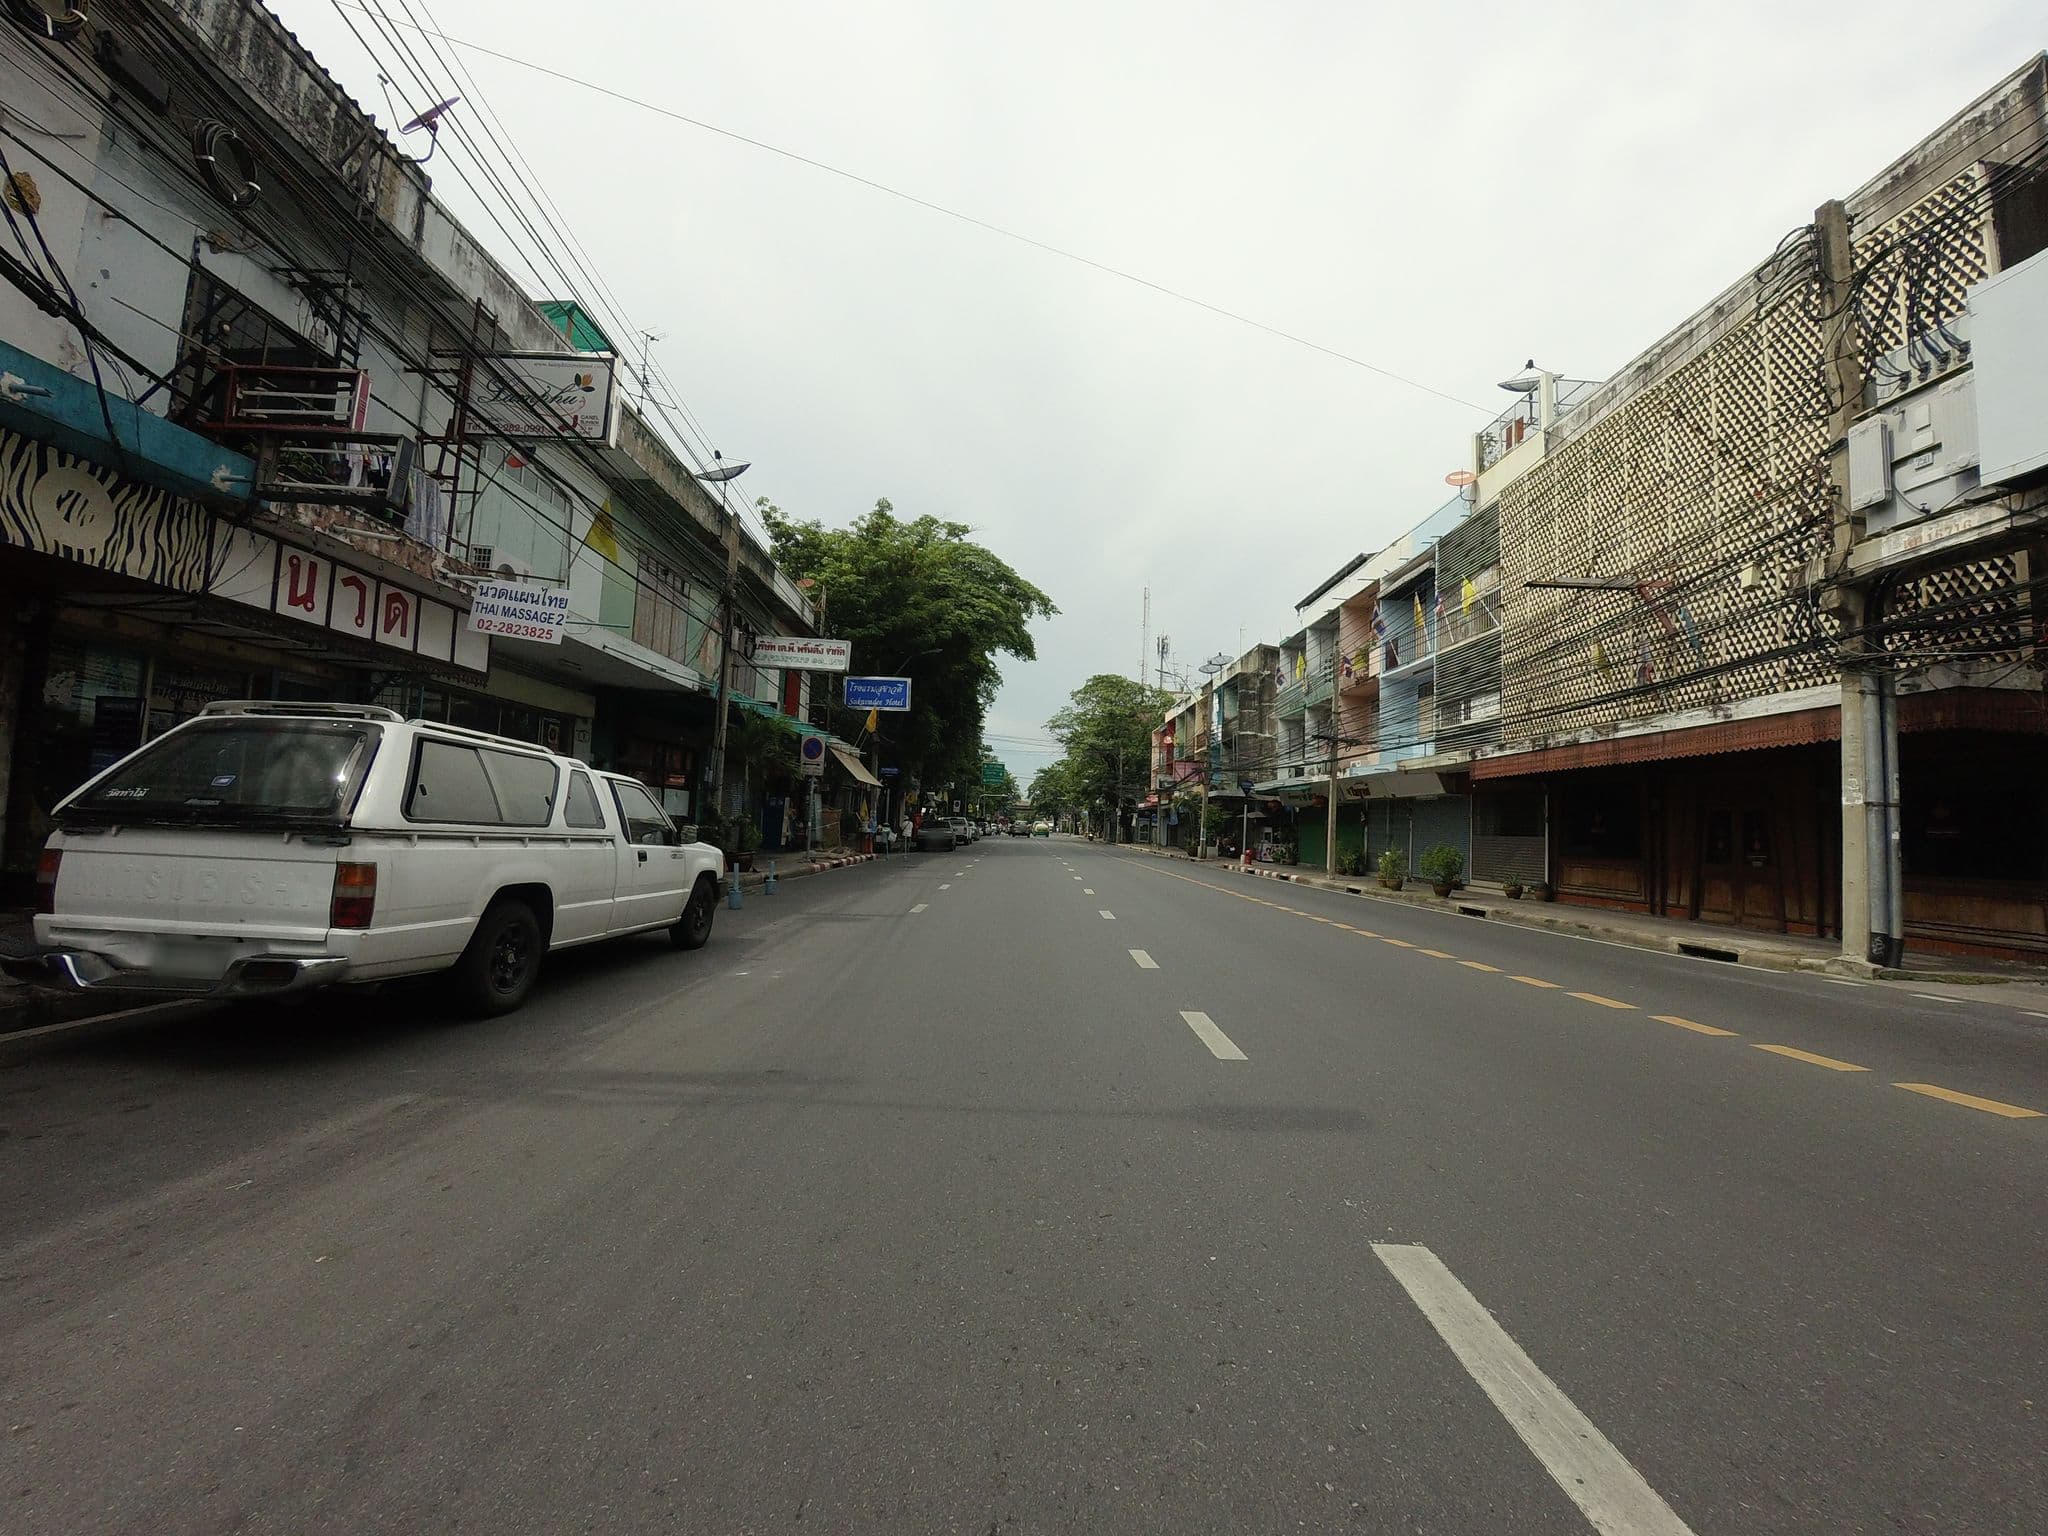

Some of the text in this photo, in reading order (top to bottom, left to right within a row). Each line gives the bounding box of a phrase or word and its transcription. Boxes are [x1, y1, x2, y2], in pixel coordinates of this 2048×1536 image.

[288, 554, 409, 638] นวด
[479, 584, 569, 609] นวดแผนไทย
[475, 601, 565, 625] THAI MASSAGE 2
[477, 618, 553, 640] 02-2823825
[884, 698, 905, 706] Hotel
